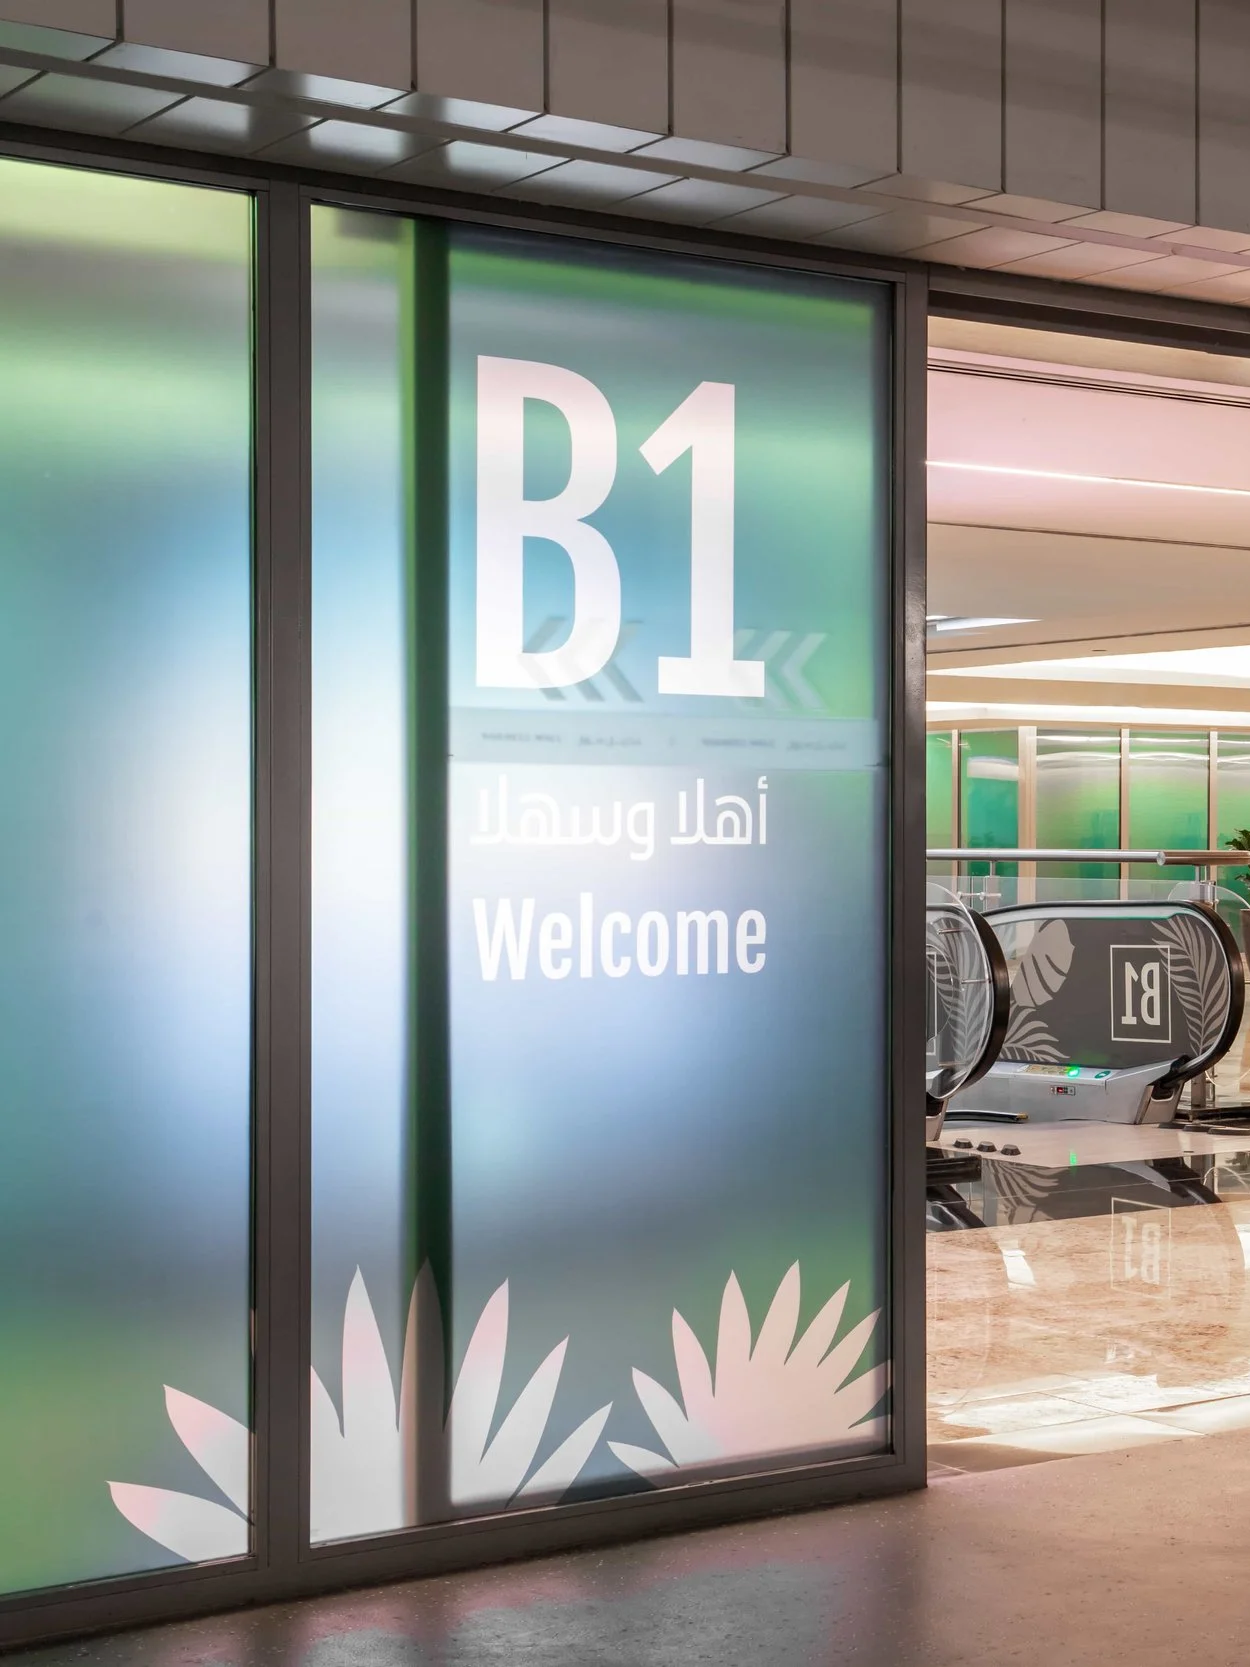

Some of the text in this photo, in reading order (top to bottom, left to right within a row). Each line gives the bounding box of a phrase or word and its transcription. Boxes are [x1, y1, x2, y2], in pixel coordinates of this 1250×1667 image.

[475, 354, 765, 698] B1
[469, 773, 769, 861] أهلا وسهلا
[472, 892, 767, 982] Welcome
